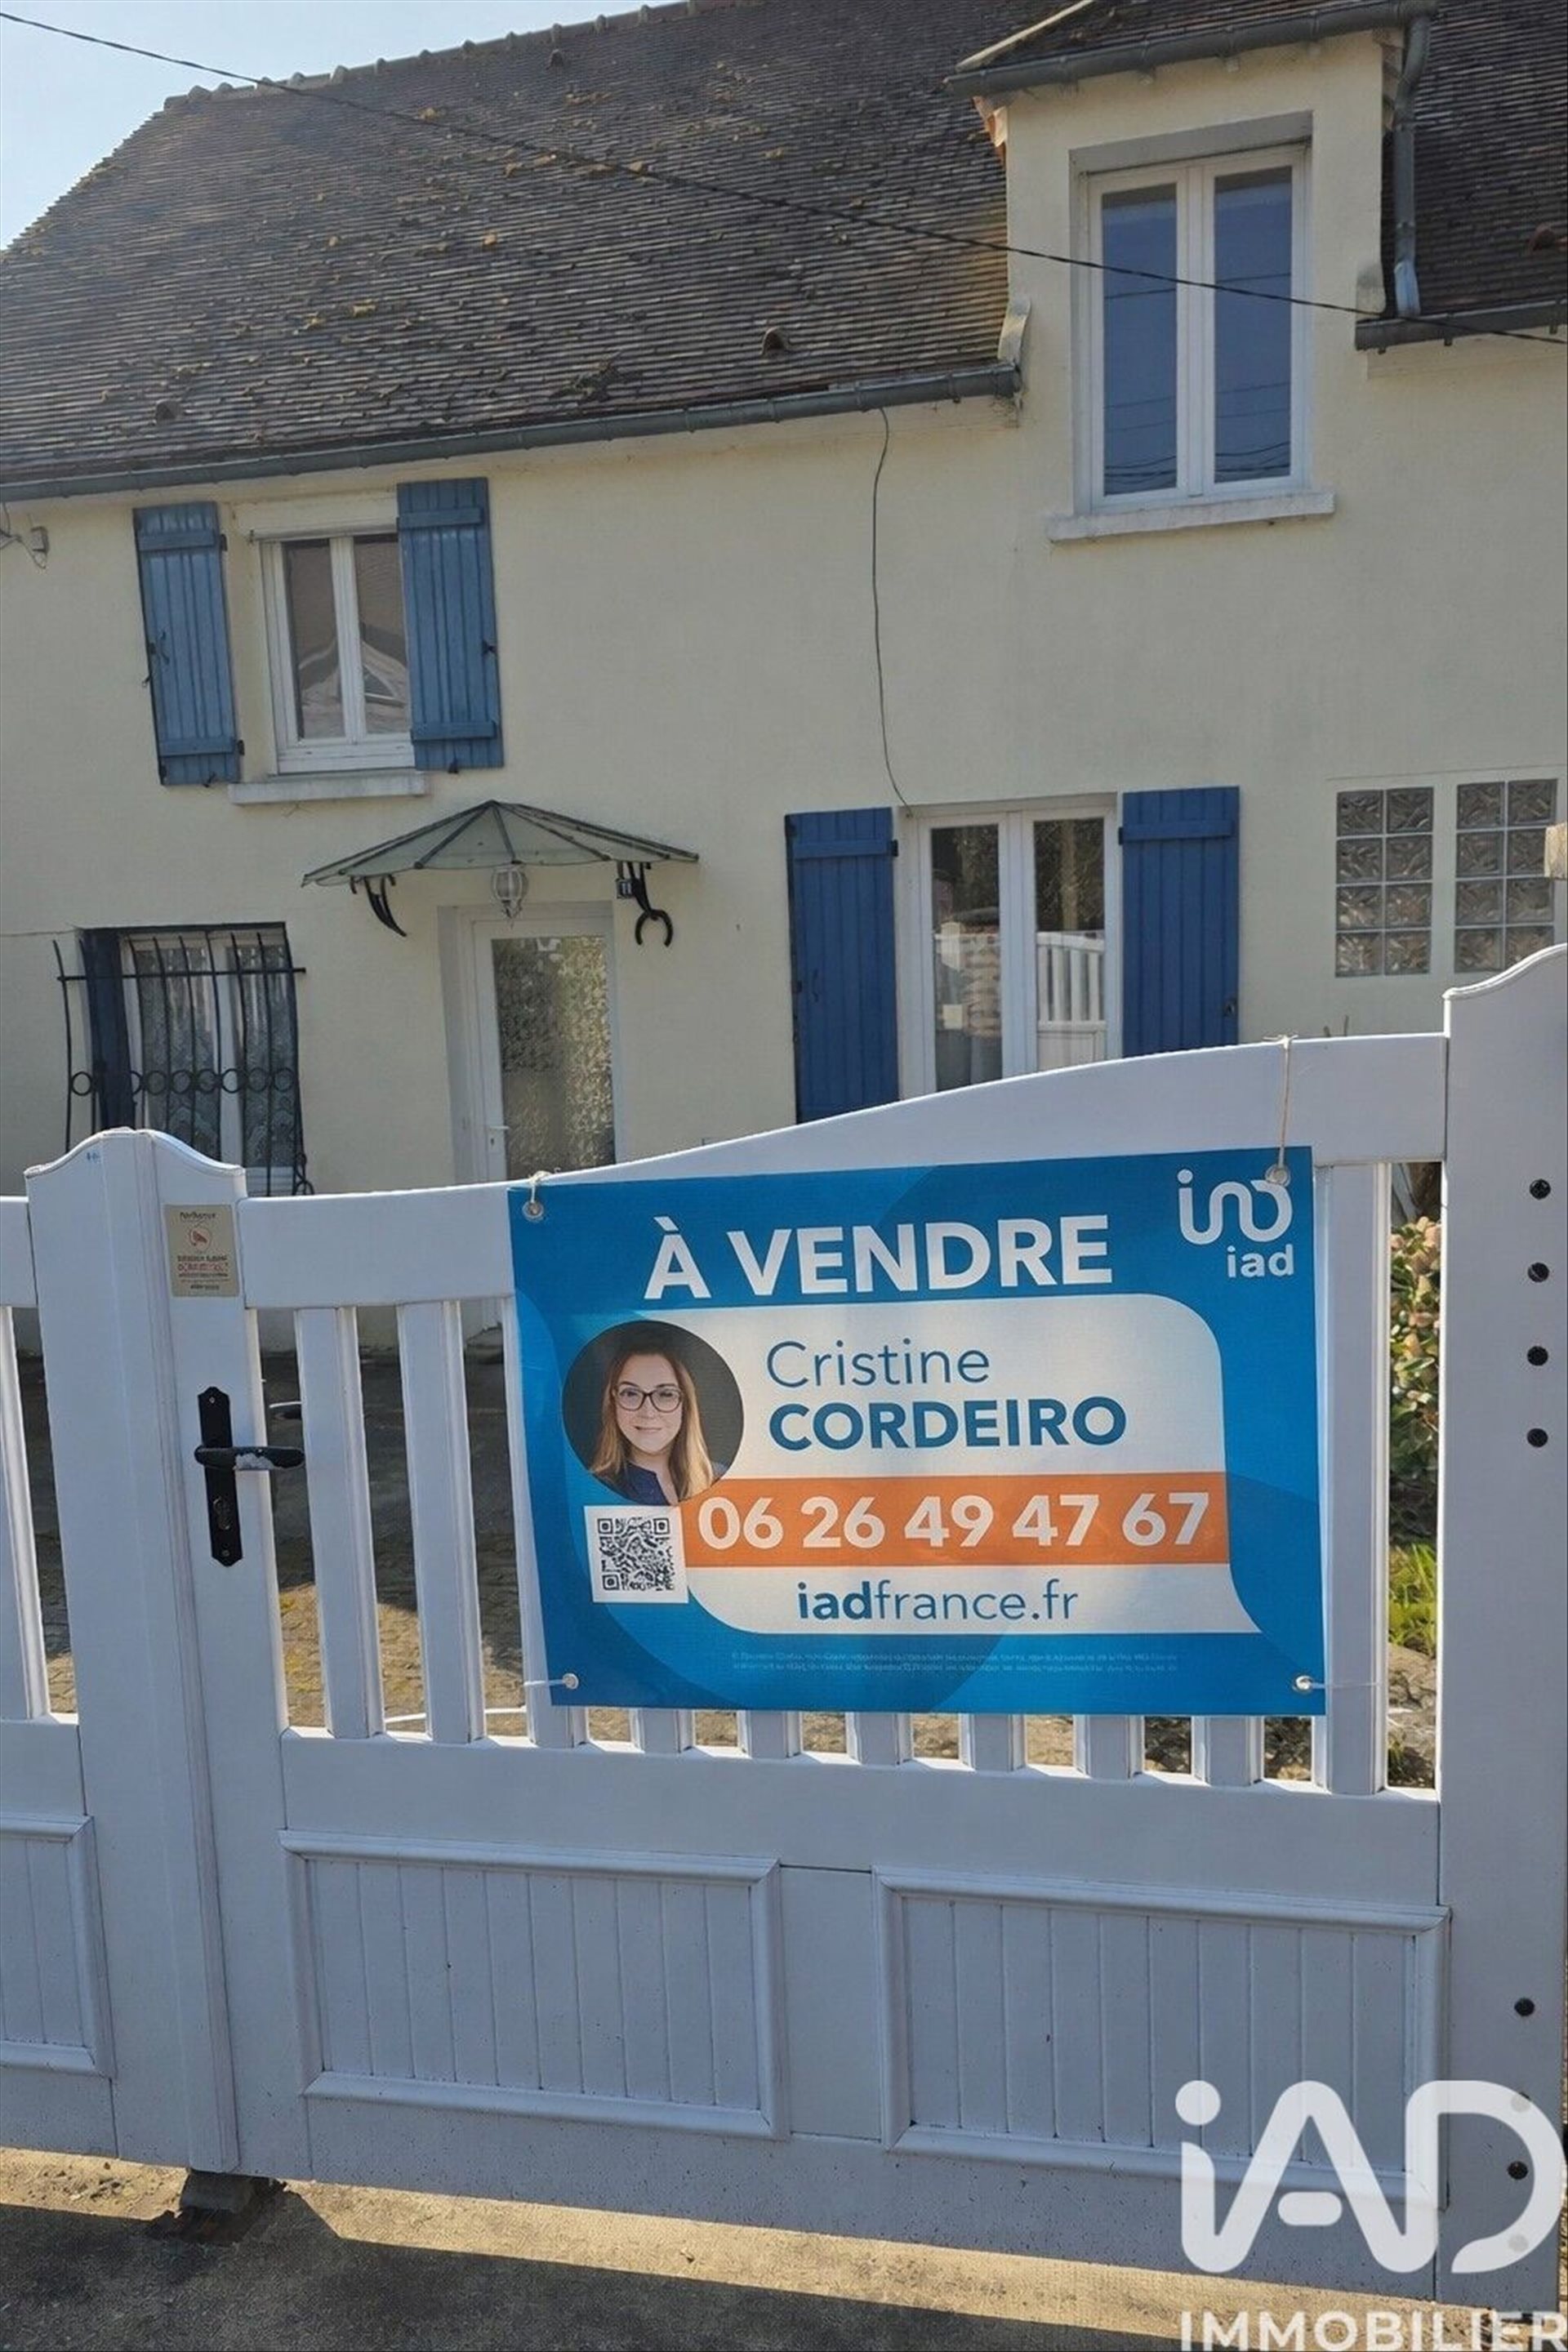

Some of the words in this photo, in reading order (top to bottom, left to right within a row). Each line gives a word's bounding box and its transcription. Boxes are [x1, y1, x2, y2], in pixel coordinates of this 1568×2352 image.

[644, 1217, 711, 1298] À
[727, 1215, 1112, 1295] VENDRE
[1227, 1244, 1294, 1277] iad
[767, 1338, 990, 1388] Cristine
[769, 1396, 1126, 1450] CORDEIRO
[698, 1496, 783, 1549] 06
[800, 1496, 884, 1548] 26
[904, 1494, 993, 1548] 49
[1012, 1494, 1099, 1547] 47
[1122, 1492, 1209, 1546] 67
[797, 1579, 1078, 1620] iadfrance.fr
